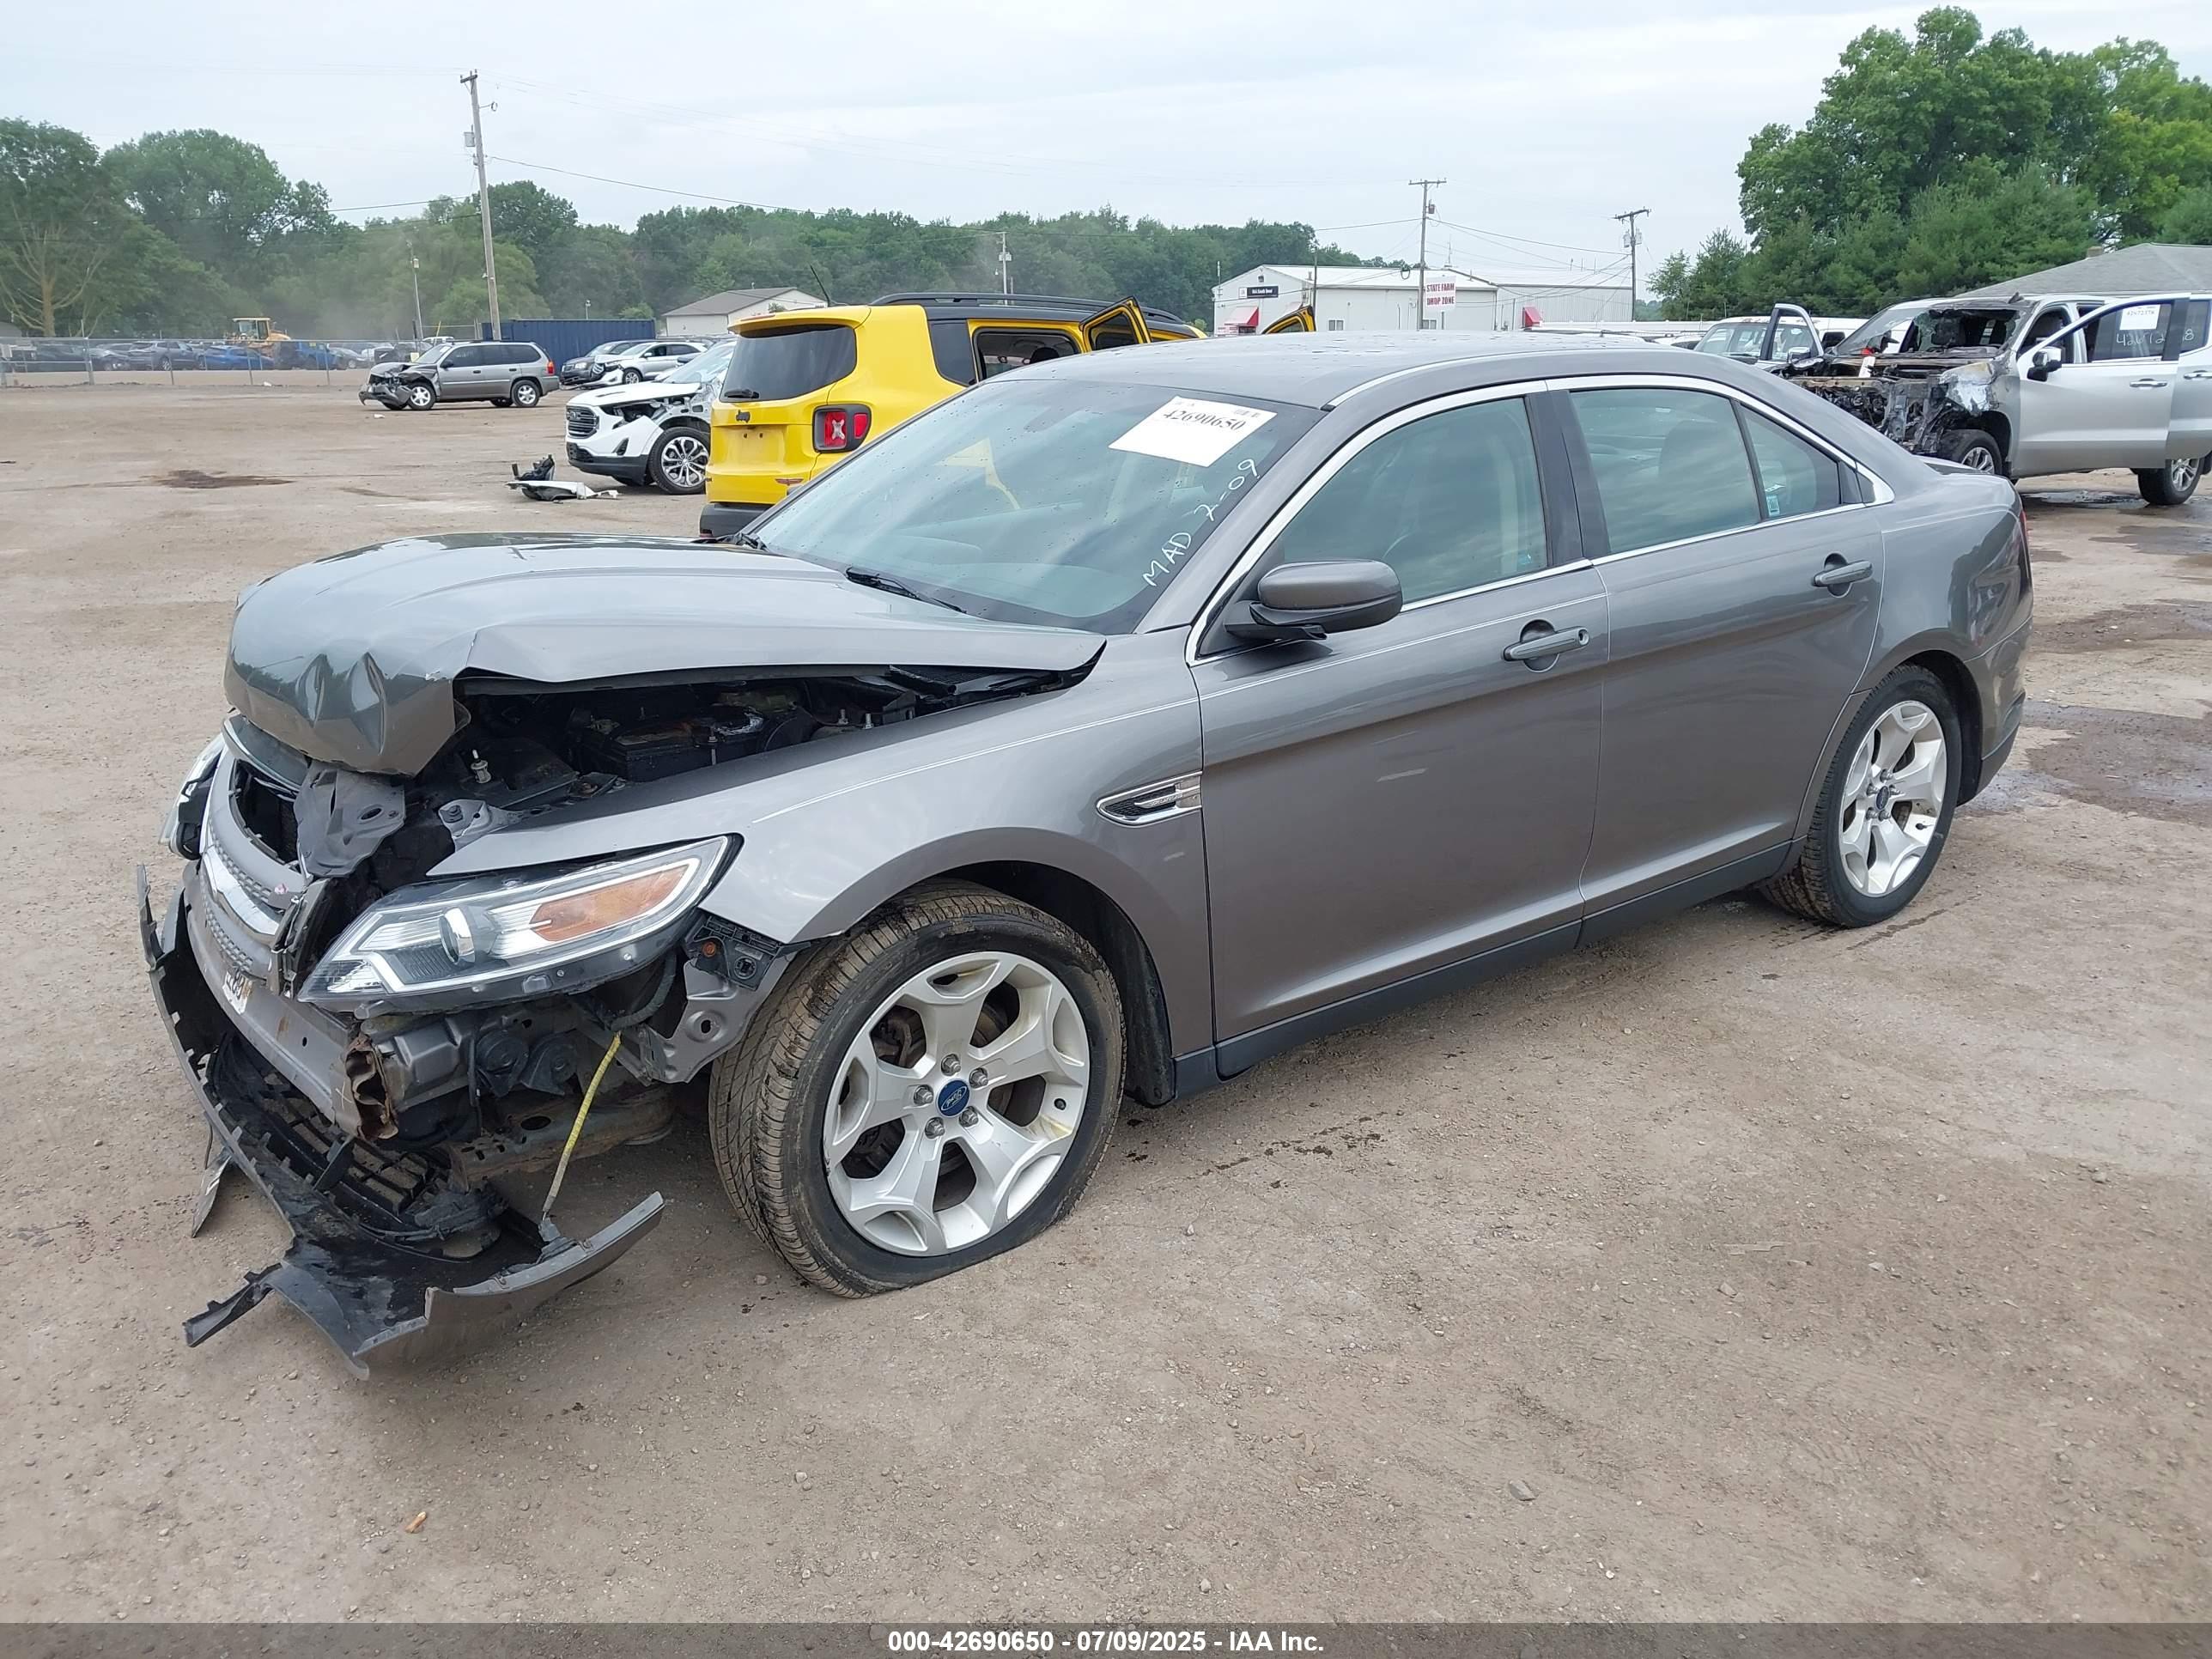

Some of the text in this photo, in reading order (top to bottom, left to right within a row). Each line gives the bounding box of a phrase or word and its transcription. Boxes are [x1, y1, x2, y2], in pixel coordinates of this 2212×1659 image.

[1426, 283, 1455, 293] STATE FARM
[1426, 296, 1455, 306] DROP ZONE
[1163, 409, 1247, 430] 42690650
[1143, 532, 1192, 586] MAD
[945, 1088, 963, 1109] Ford
